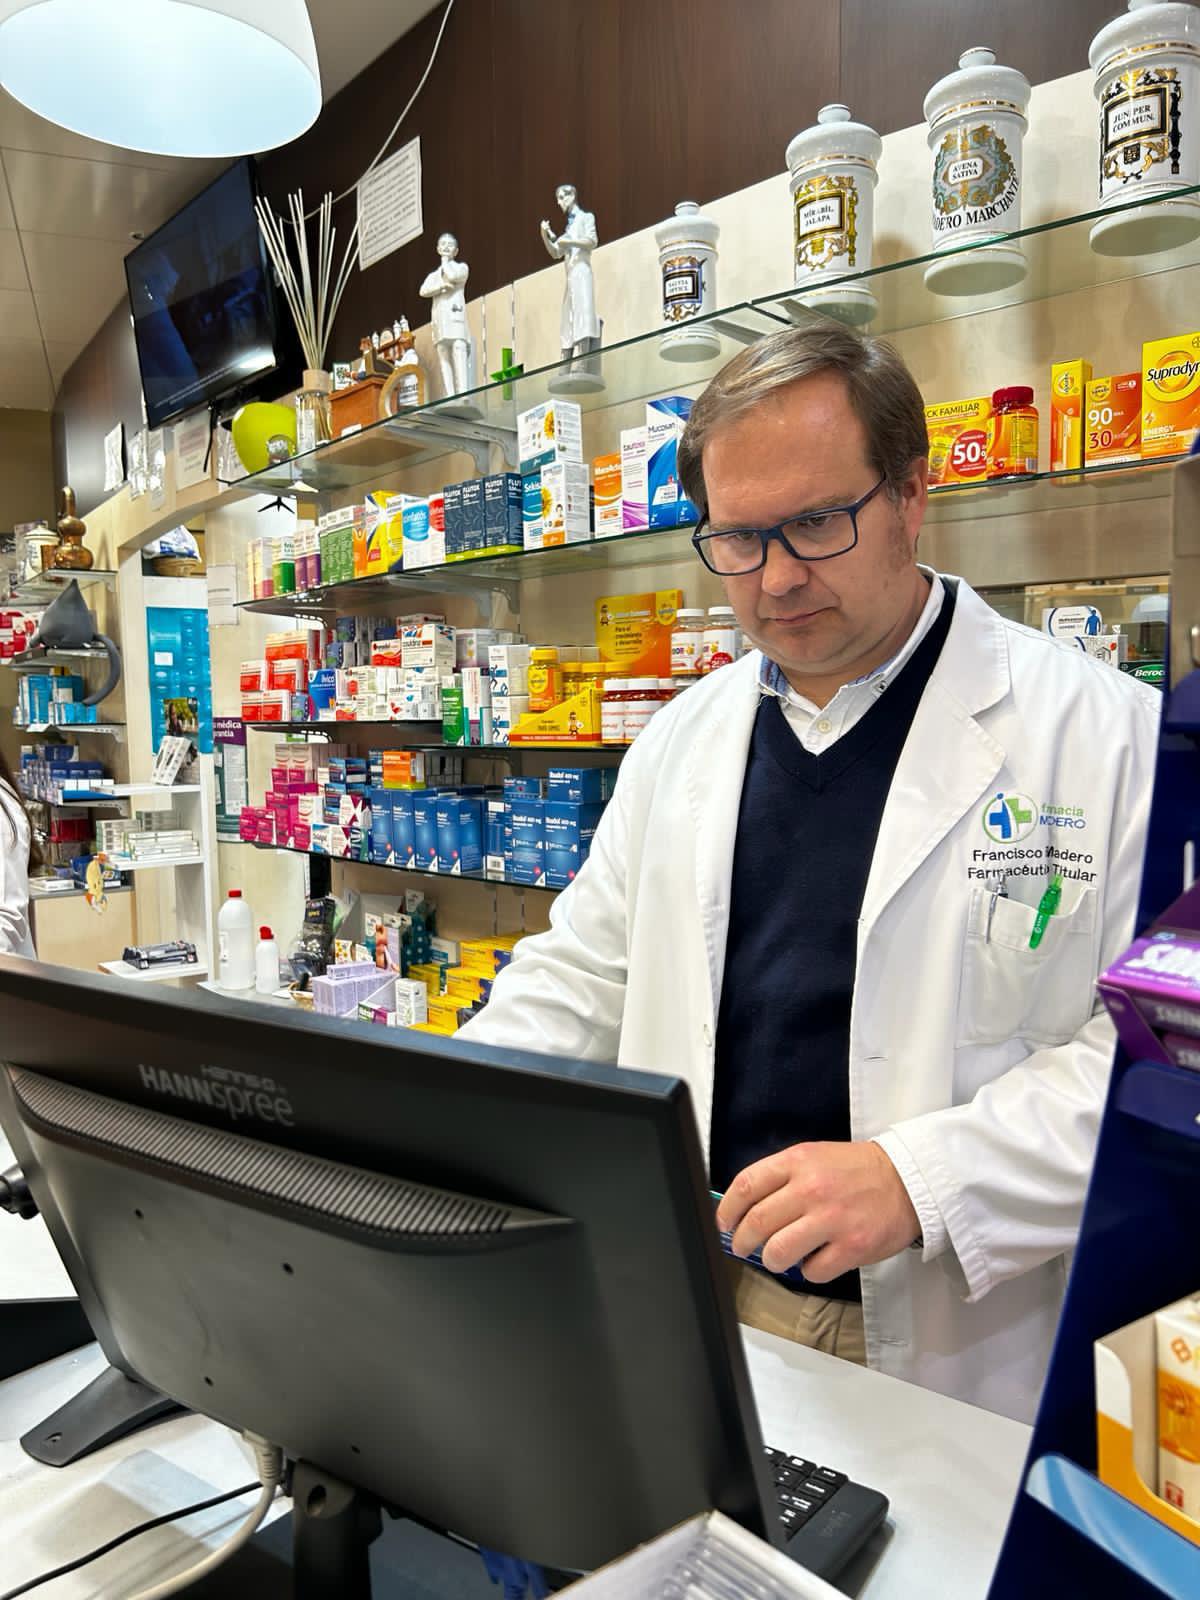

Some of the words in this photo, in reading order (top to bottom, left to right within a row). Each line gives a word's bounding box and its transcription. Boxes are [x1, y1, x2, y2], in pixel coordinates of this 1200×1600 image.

[952, 169, 978, 179] SATIVA
[953, 161, 978, 172] AVENA
[940, 402, 980, 416] FAMILIAR
[1088, 408, 1113, 427] 90
[648, 422, 675, 433] Mucosan
[1089, 430, 1112, 449] 30
[973, 847, 1042, 862] Francisco
[1052, 863, 1097, 882] Titular
[138, 1063, 296, 1127] HANNspree
